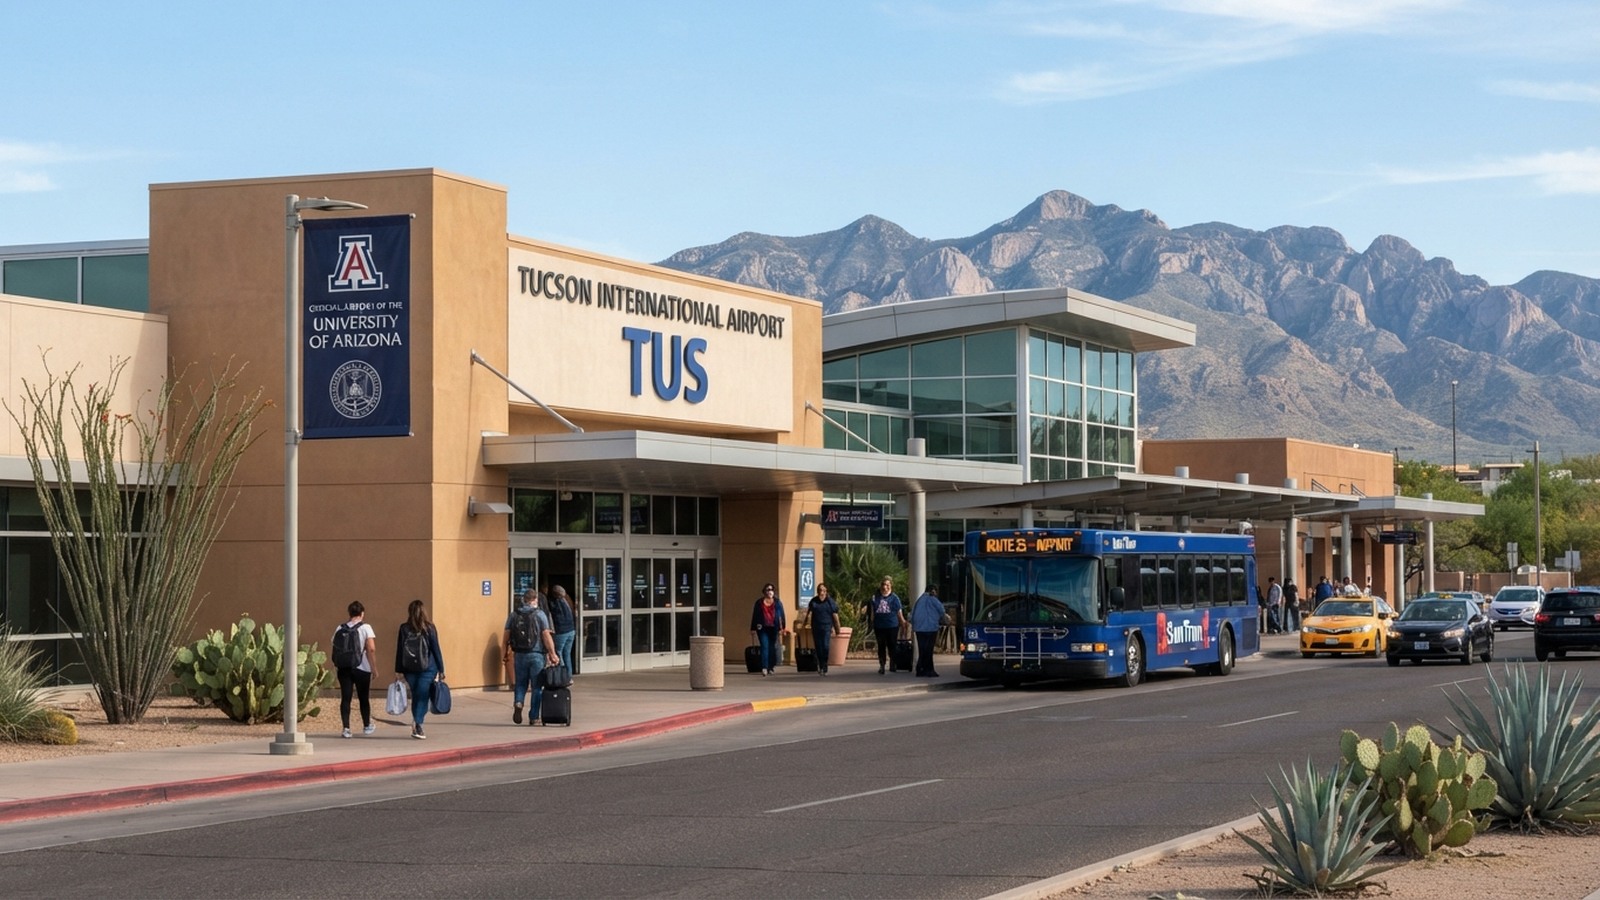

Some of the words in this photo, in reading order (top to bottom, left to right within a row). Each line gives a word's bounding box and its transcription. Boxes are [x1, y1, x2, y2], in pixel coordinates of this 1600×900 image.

[313, 314, 399, 331] UNIVERSITY
[517, 265, 592, 306] TUCSON
[597, 281, 724, 329] INTERNATIONAL
[726, 307, 785, 339] AIRPORT
[309, 335, 330, 349] OF
[332, 332, 402, 348] ARIZONA
[622, 326, 709, 404] TUS
